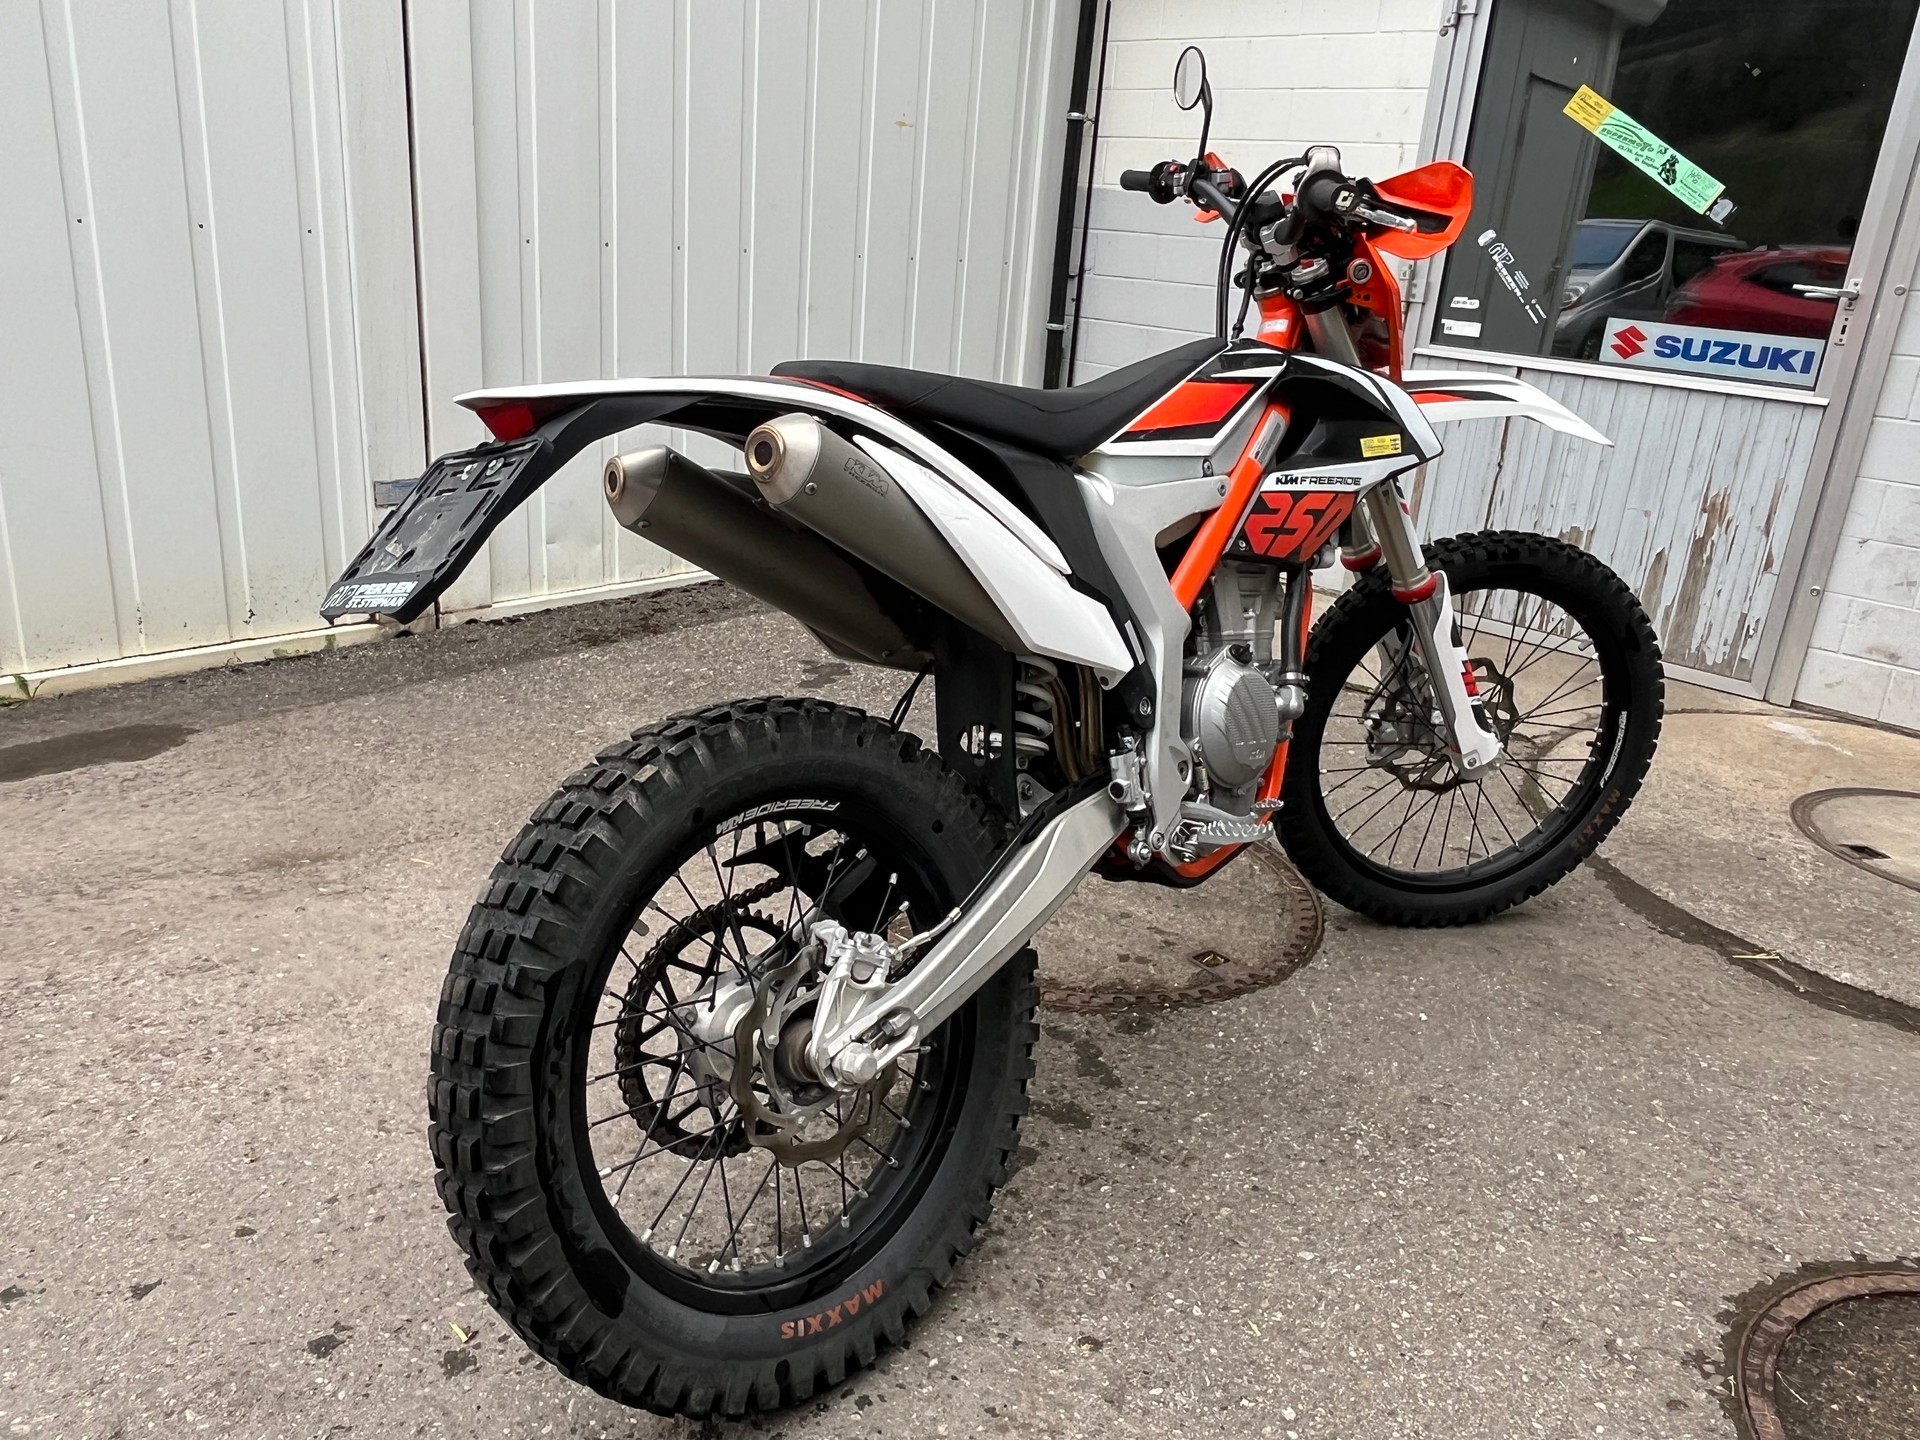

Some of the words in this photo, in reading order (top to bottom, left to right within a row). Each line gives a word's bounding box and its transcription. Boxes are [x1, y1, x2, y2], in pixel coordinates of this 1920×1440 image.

[1653, 335, 1816, 375] SUZUKI
[1275, 474, 1299, 485] KTM
[1300, 476, 1362, 486] FREERIDE
[1244, 492, 1357, 562] 250
[356, 581, 419, 596] PERREN
[744, 799, 840, 821] FREERIDE
[781, 1279, 884, 1339] MAXXIS
